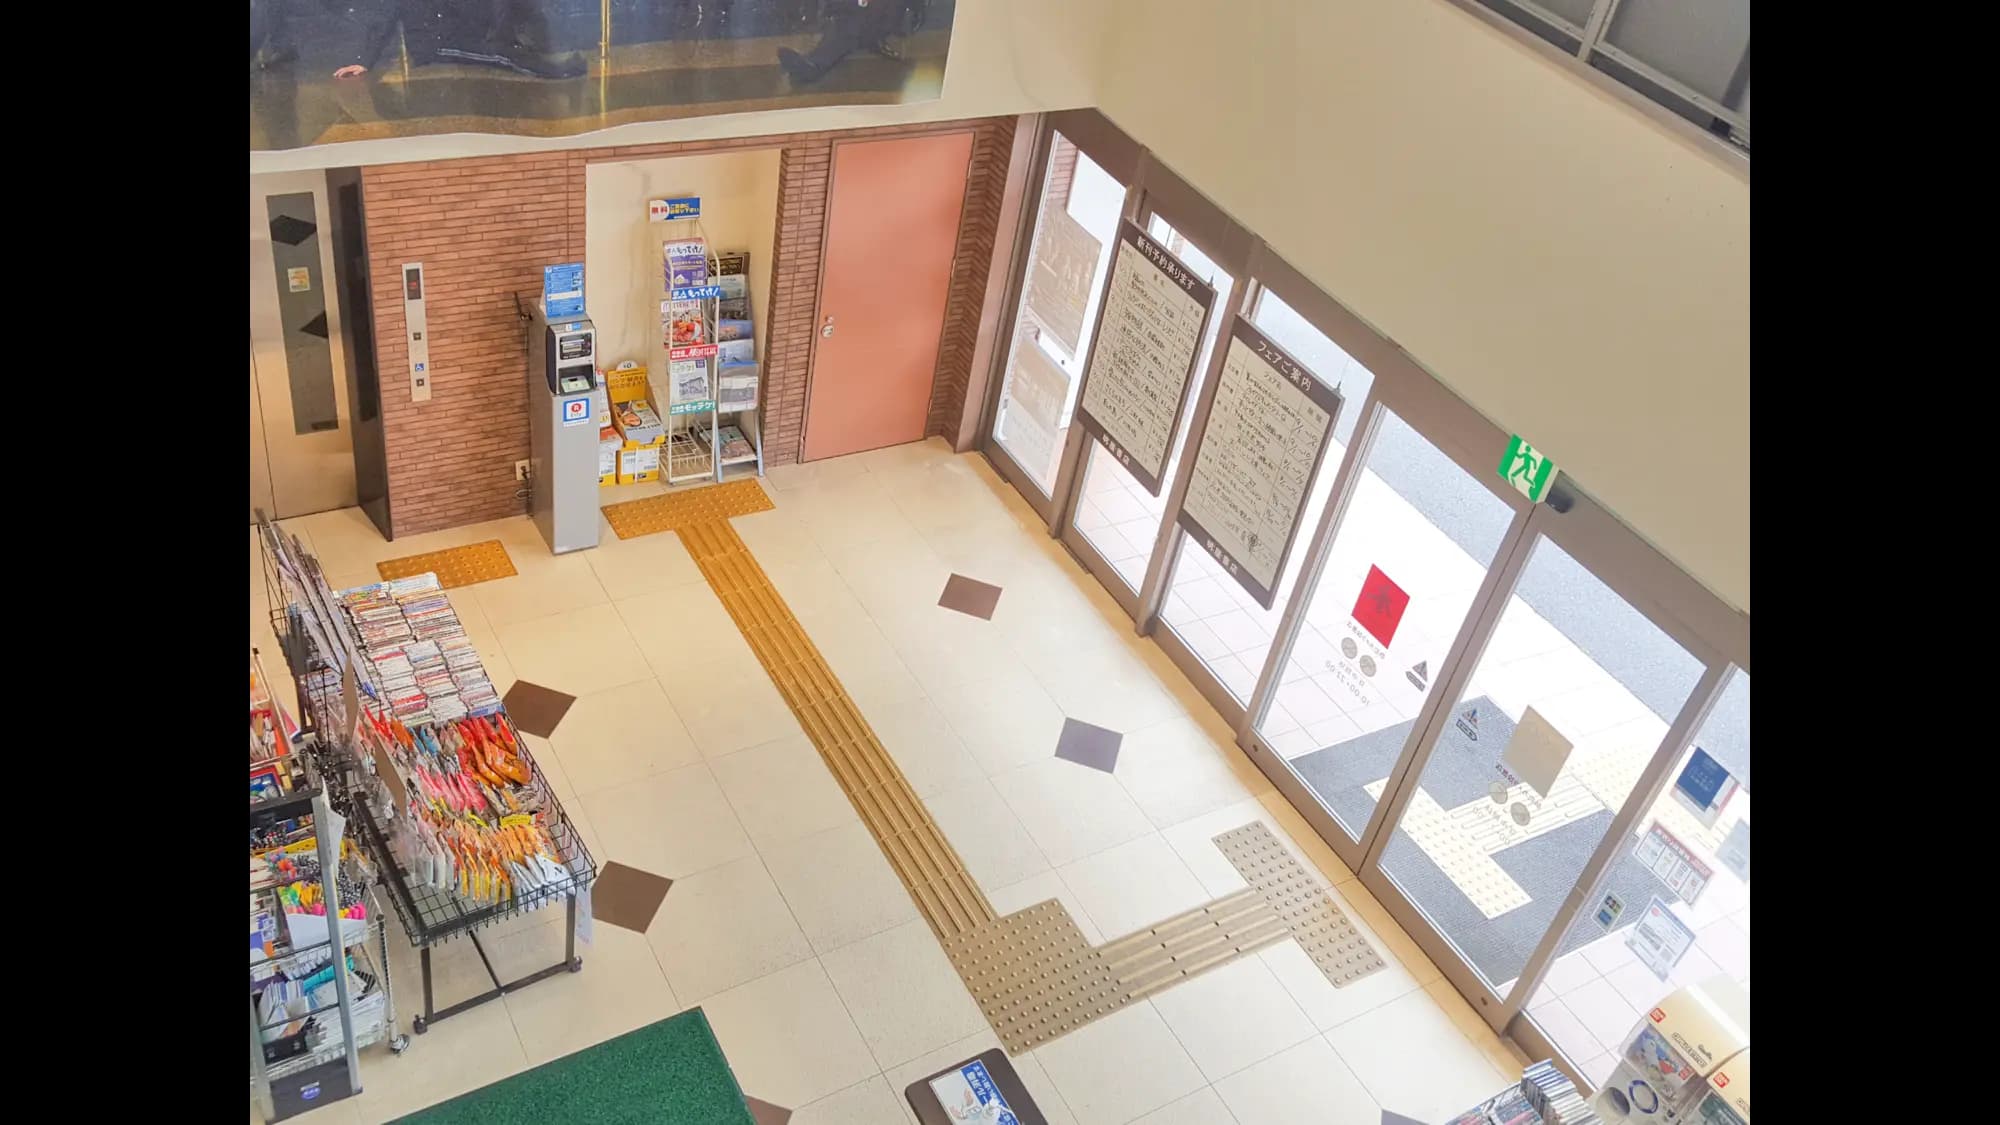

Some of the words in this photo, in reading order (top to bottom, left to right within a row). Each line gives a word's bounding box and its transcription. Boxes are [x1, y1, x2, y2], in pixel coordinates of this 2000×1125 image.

[1137, 235, 1195, 290] 新刊予約承ります
[1257, 340, 1312, 391] フェアご案内
